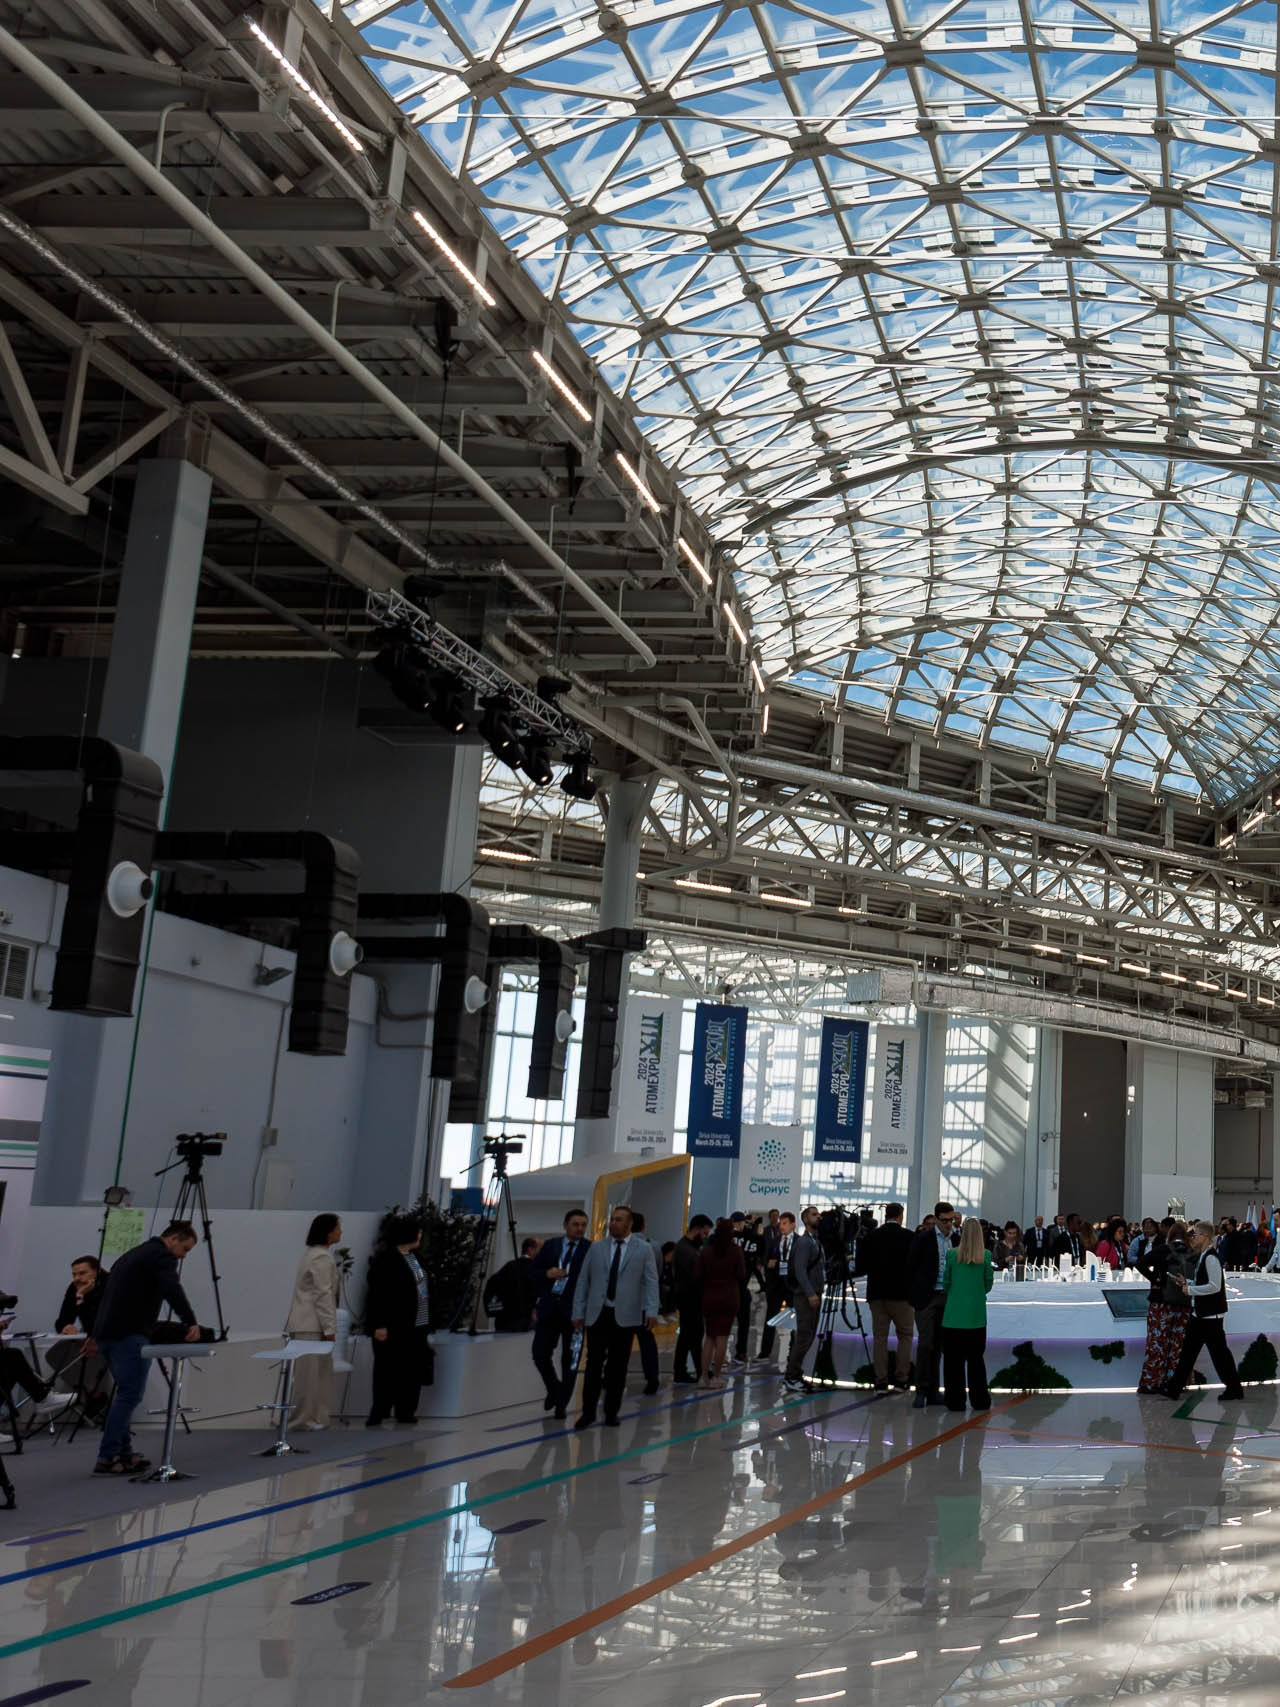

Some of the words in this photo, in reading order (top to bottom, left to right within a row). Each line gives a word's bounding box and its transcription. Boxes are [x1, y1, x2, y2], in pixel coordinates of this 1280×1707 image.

[637, 1057, 648, 1080] 2024
[704, 1062, 715, 1086] 2024
[645, 1058, 661, 1114] ATOMEXPO
[712, 1063, 727, 1119] ATOMEXPO
[830, 1073, 840, 1094] 2024
[884, 1078, 893, 1099] 2024
[837, 1073, 850, 1126] ATOMEXPO
[891, 1079, 903, 1129] ATOMEXPO
[749, 1183, 790, 1196] Сириус
